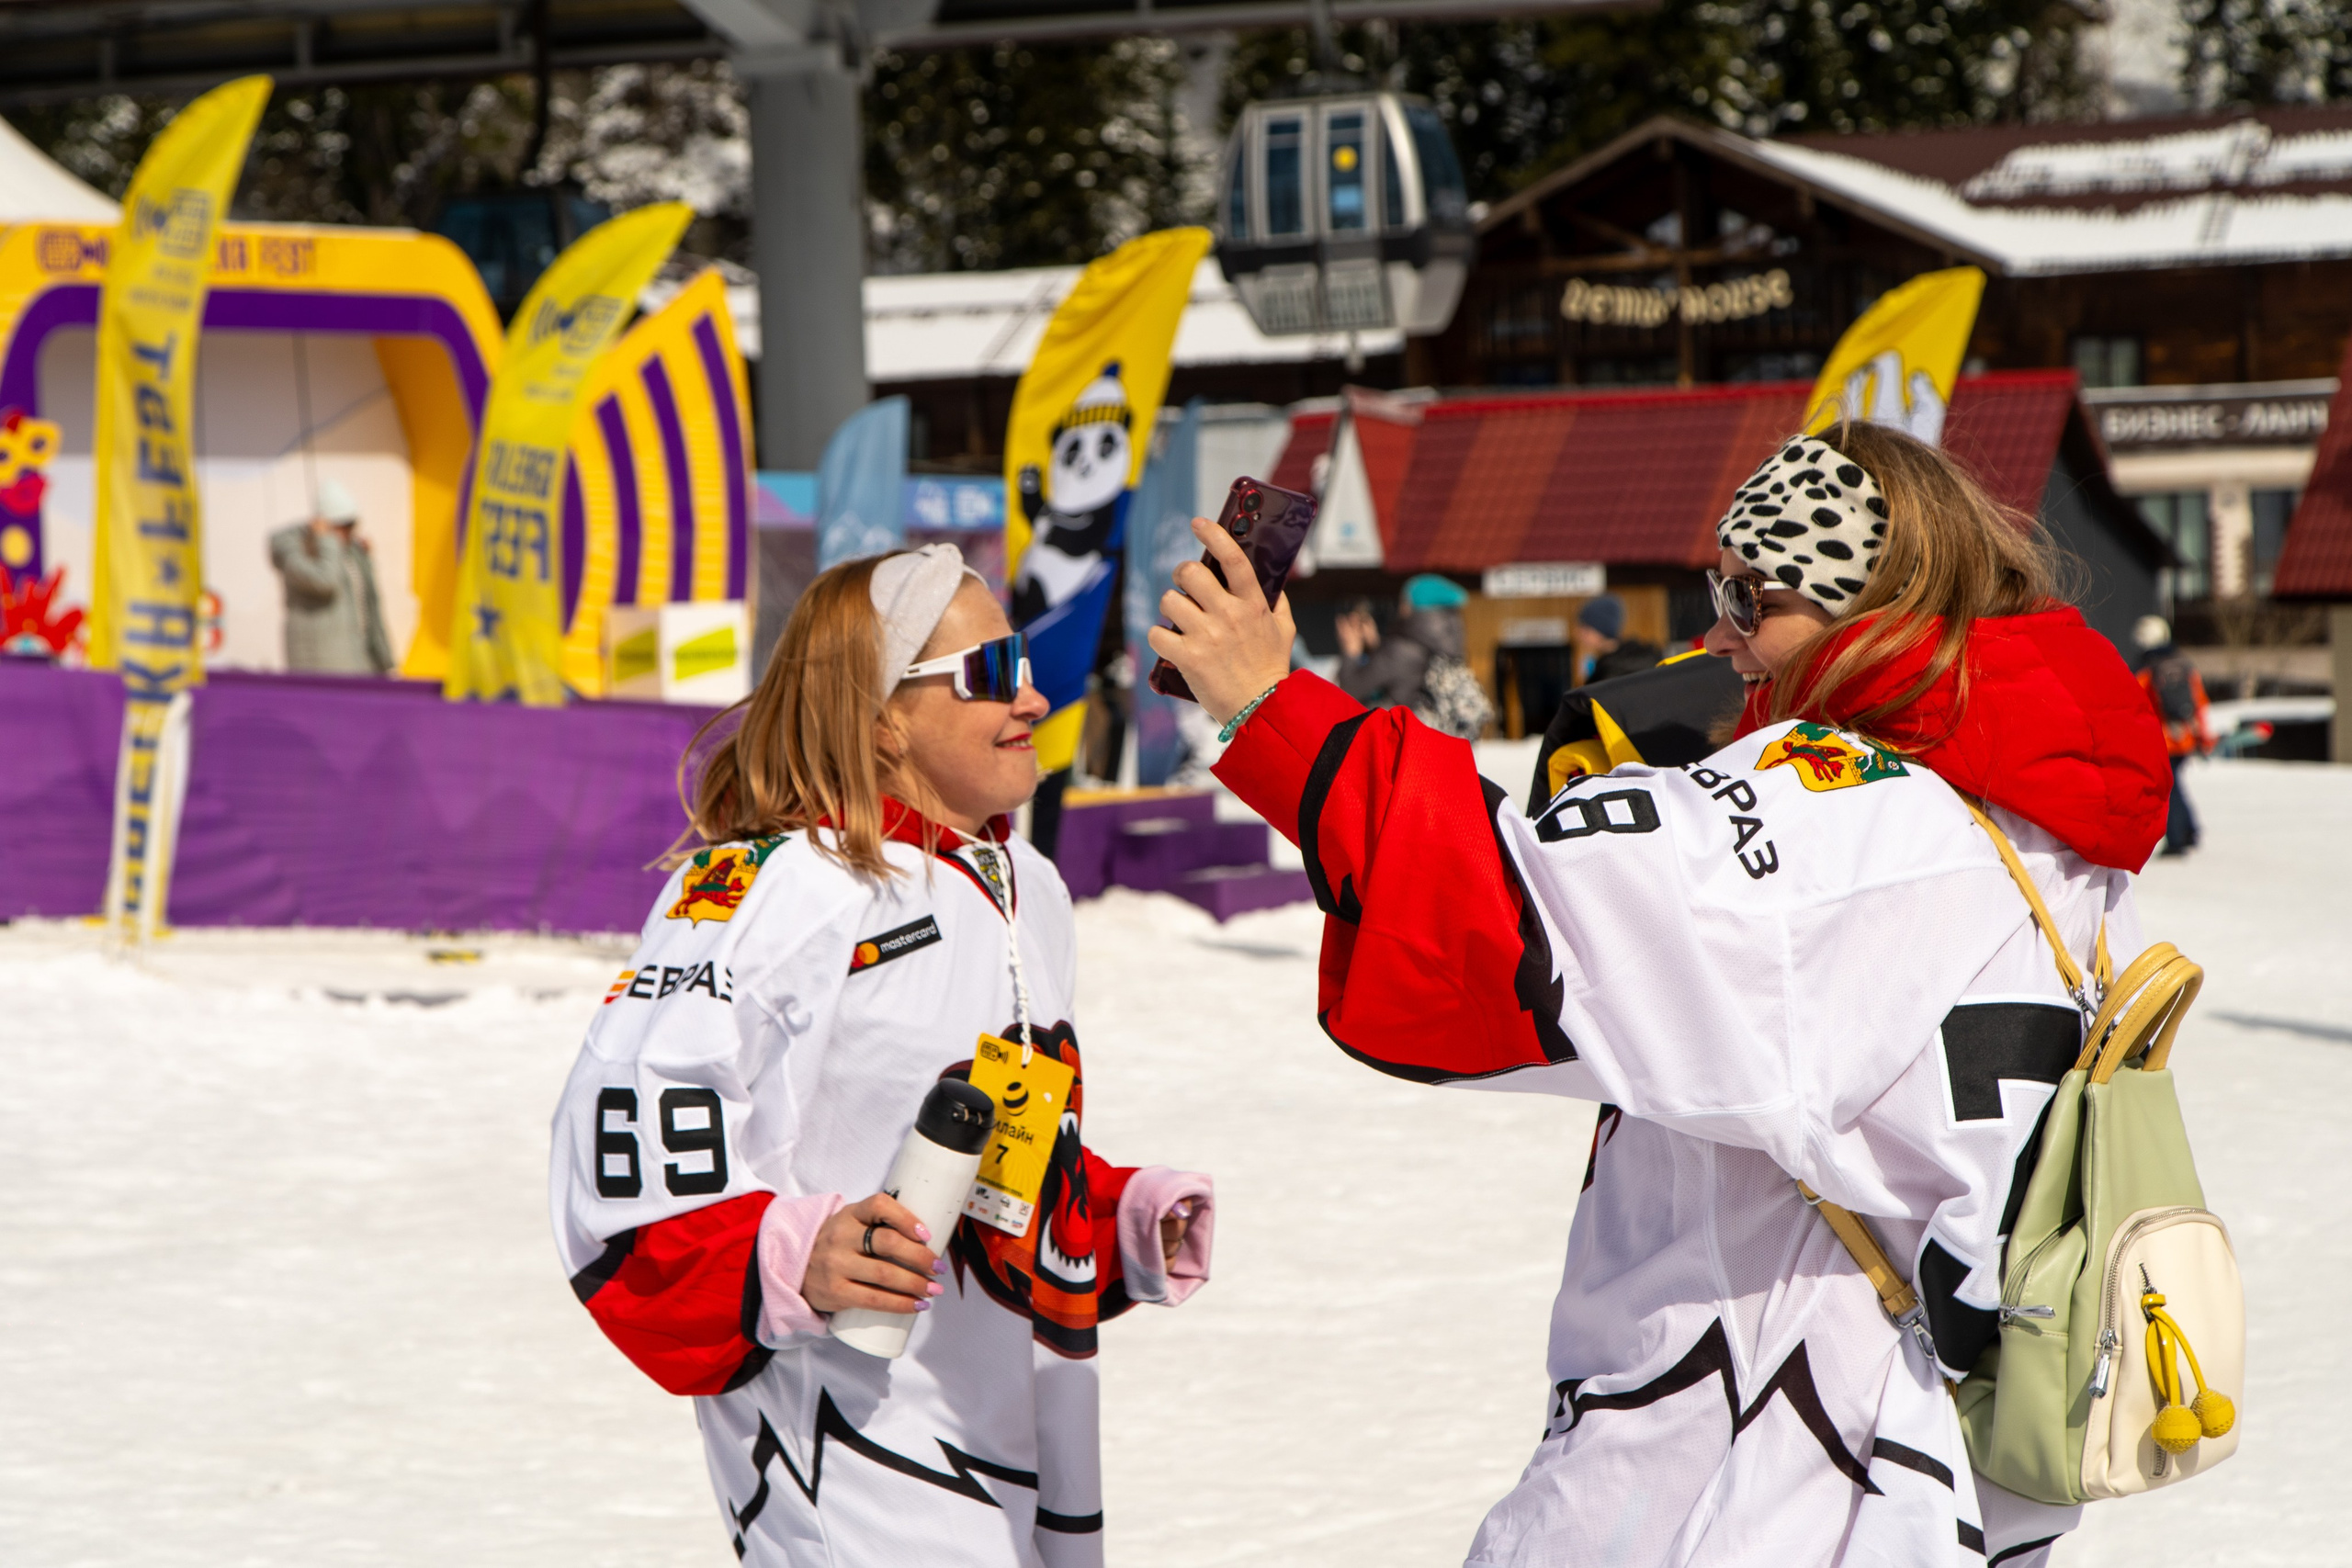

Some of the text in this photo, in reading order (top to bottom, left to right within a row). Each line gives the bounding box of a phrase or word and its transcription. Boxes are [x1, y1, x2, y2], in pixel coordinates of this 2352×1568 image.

[1679, 762, 1780, 880] ВРАЗ
[879, 922, 938, 953] mastercard
[596, 1087, 729, 1198] 69
[995, 1120, 1035, 1146] илайн
[995, 1143, 1009, 1165] 7
